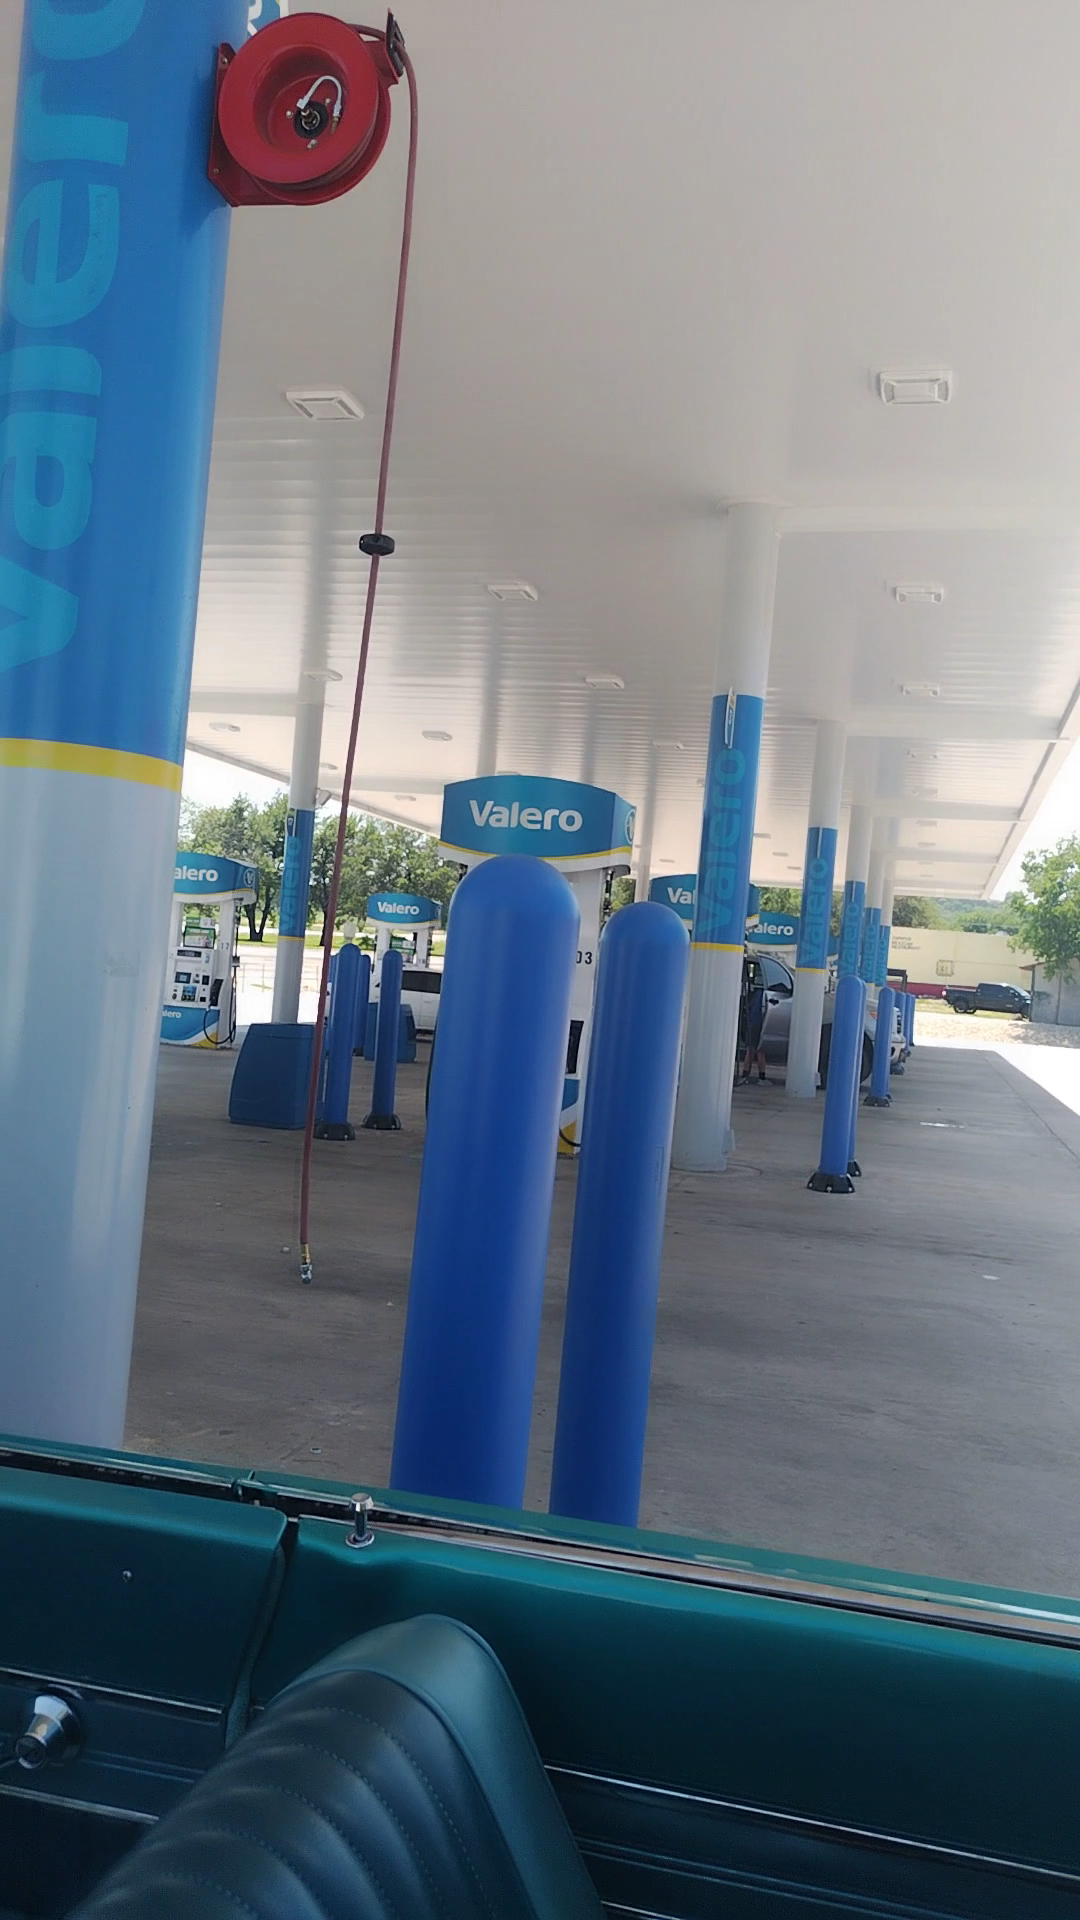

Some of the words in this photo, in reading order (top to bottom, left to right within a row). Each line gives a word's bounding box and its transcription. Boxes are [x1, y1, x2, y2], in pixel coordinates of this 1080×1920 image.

[470, 800, 583, 832] Valero
[695, 749, 746, 935] Valero
[174, 865, 218, 881] alero
[667, 887, 696, 904] Val
[377, 901, 420, 915] Valero
[801, 858, 828, 963] Valero
[753, 922, 794, 936] alero
[162, 1009, 182, 1019] alero
